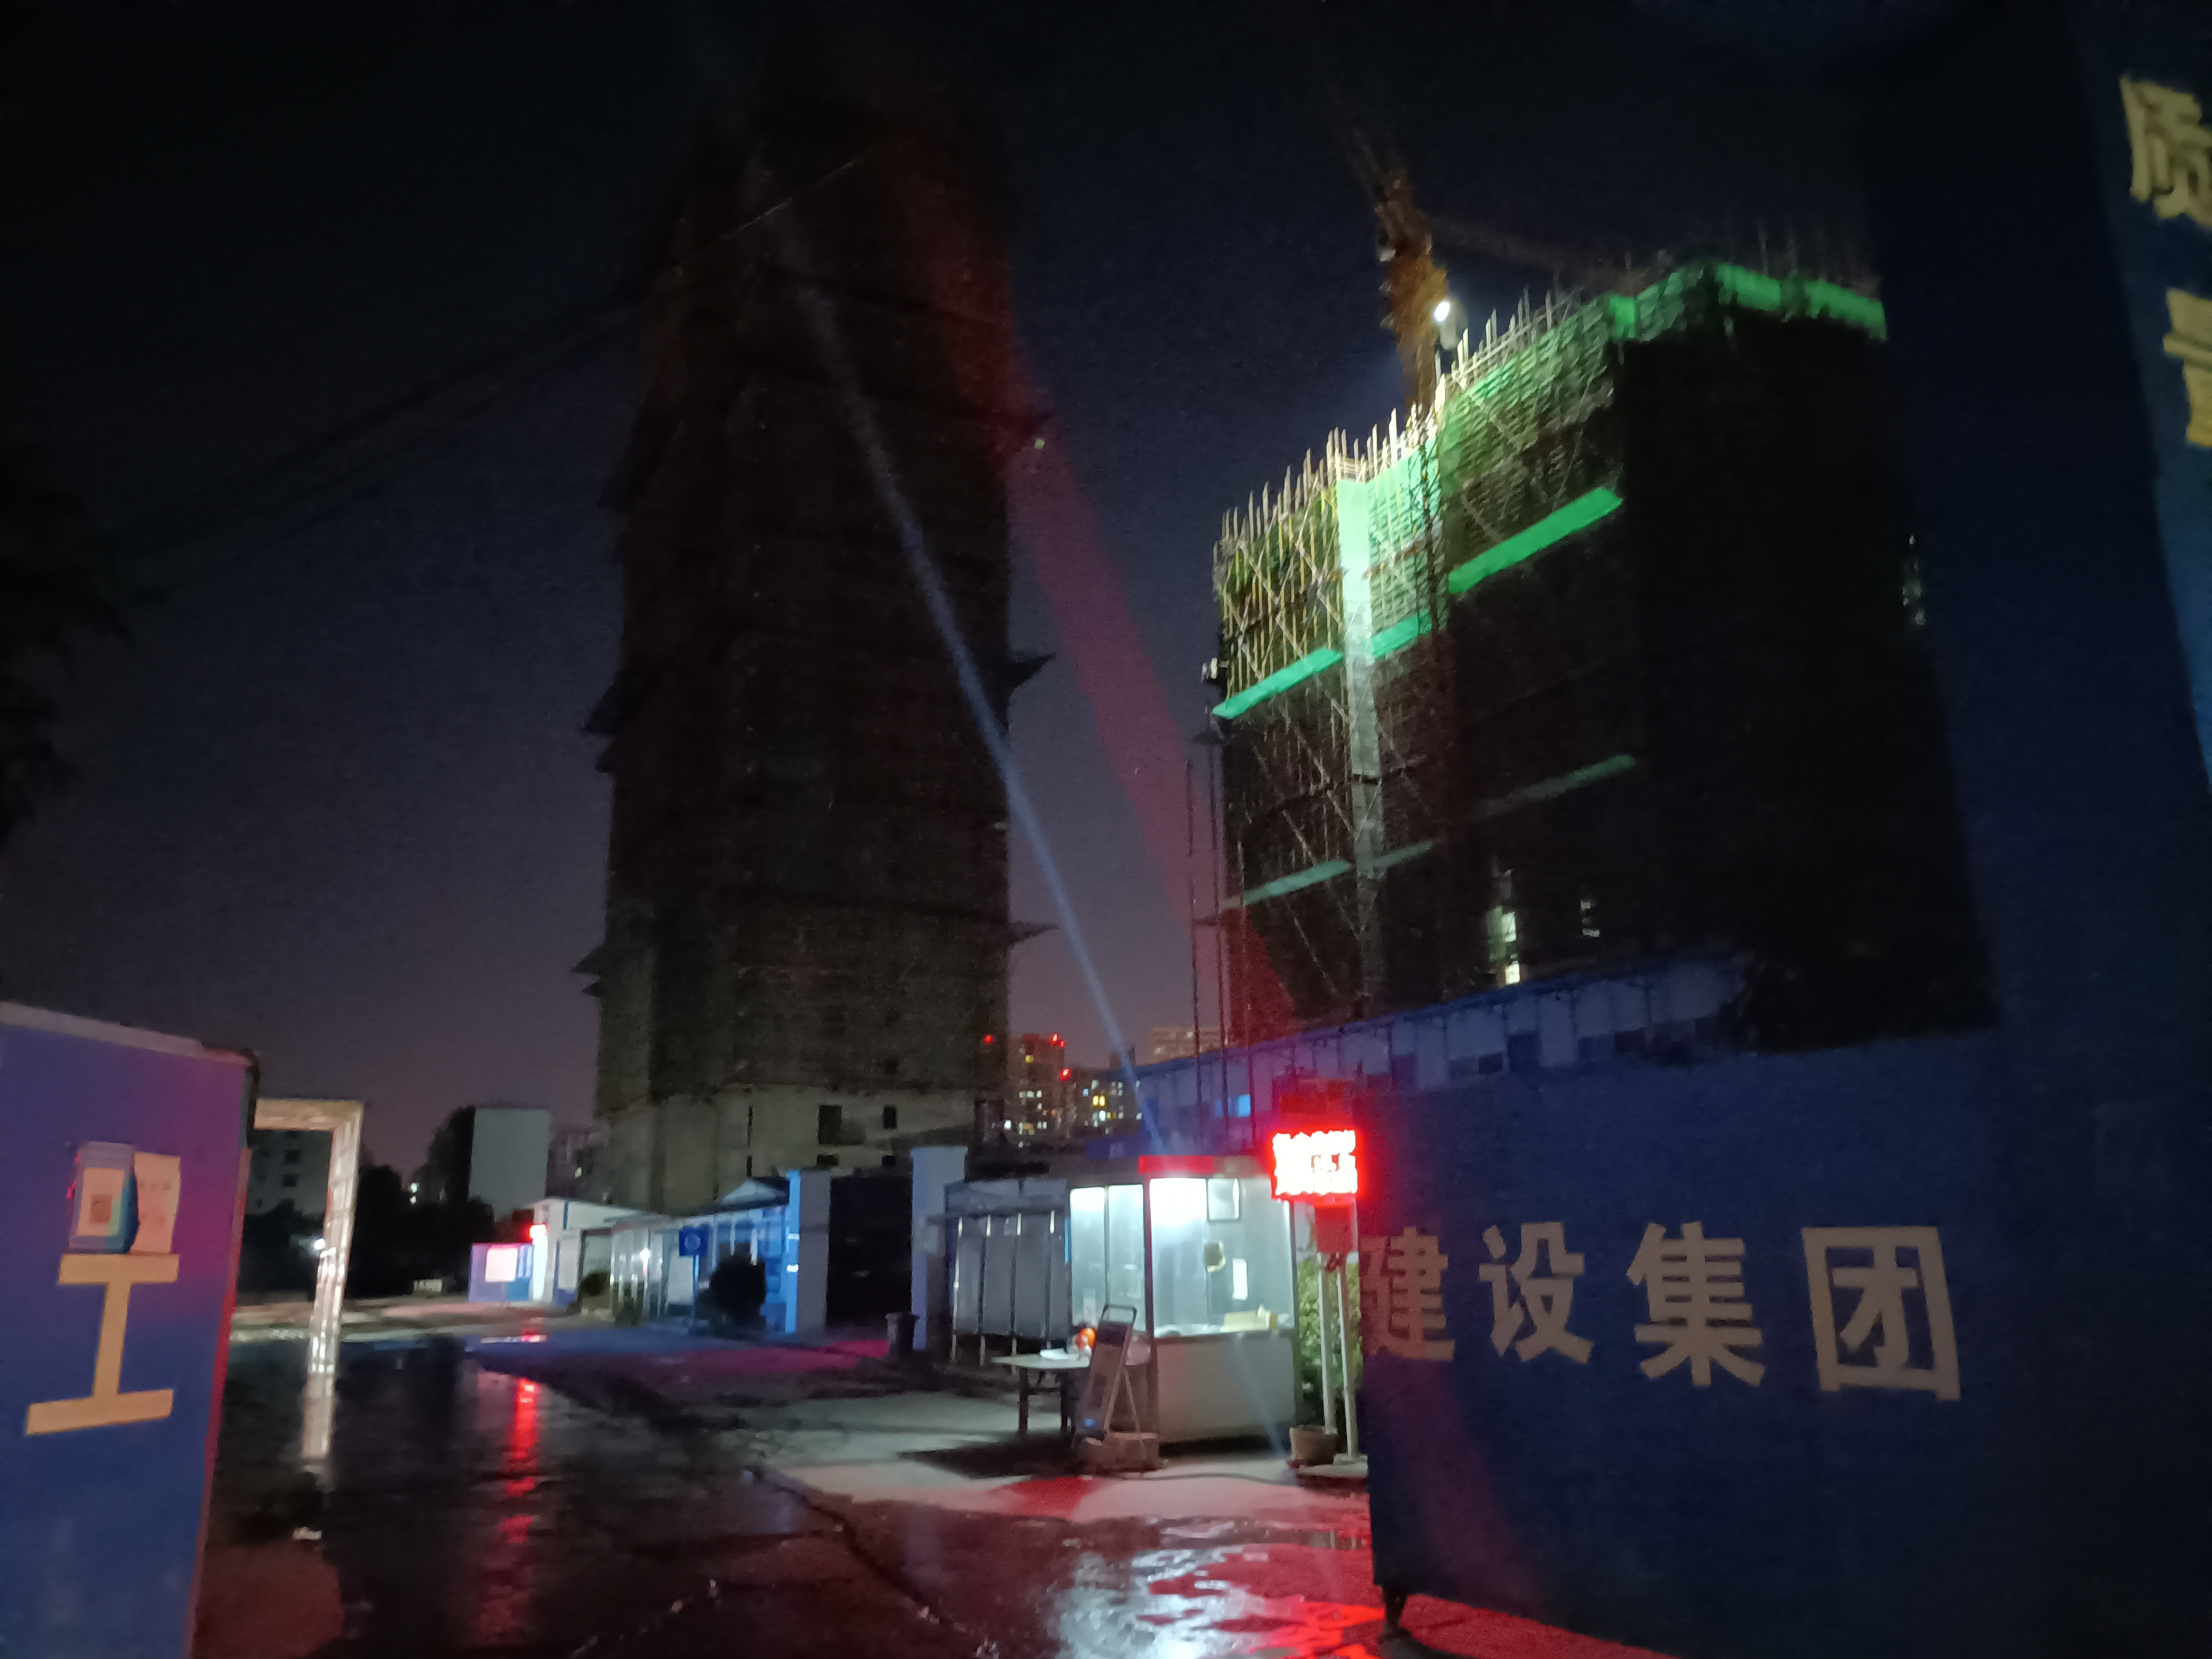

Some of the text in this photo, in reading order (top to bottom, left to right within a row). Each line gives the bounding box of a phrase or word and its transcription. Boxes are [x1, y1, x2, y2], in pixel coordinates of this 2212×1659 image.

[24, 1253, 180, 1437] 工
[1359, 1220, 1962, 1402] 建设集团
